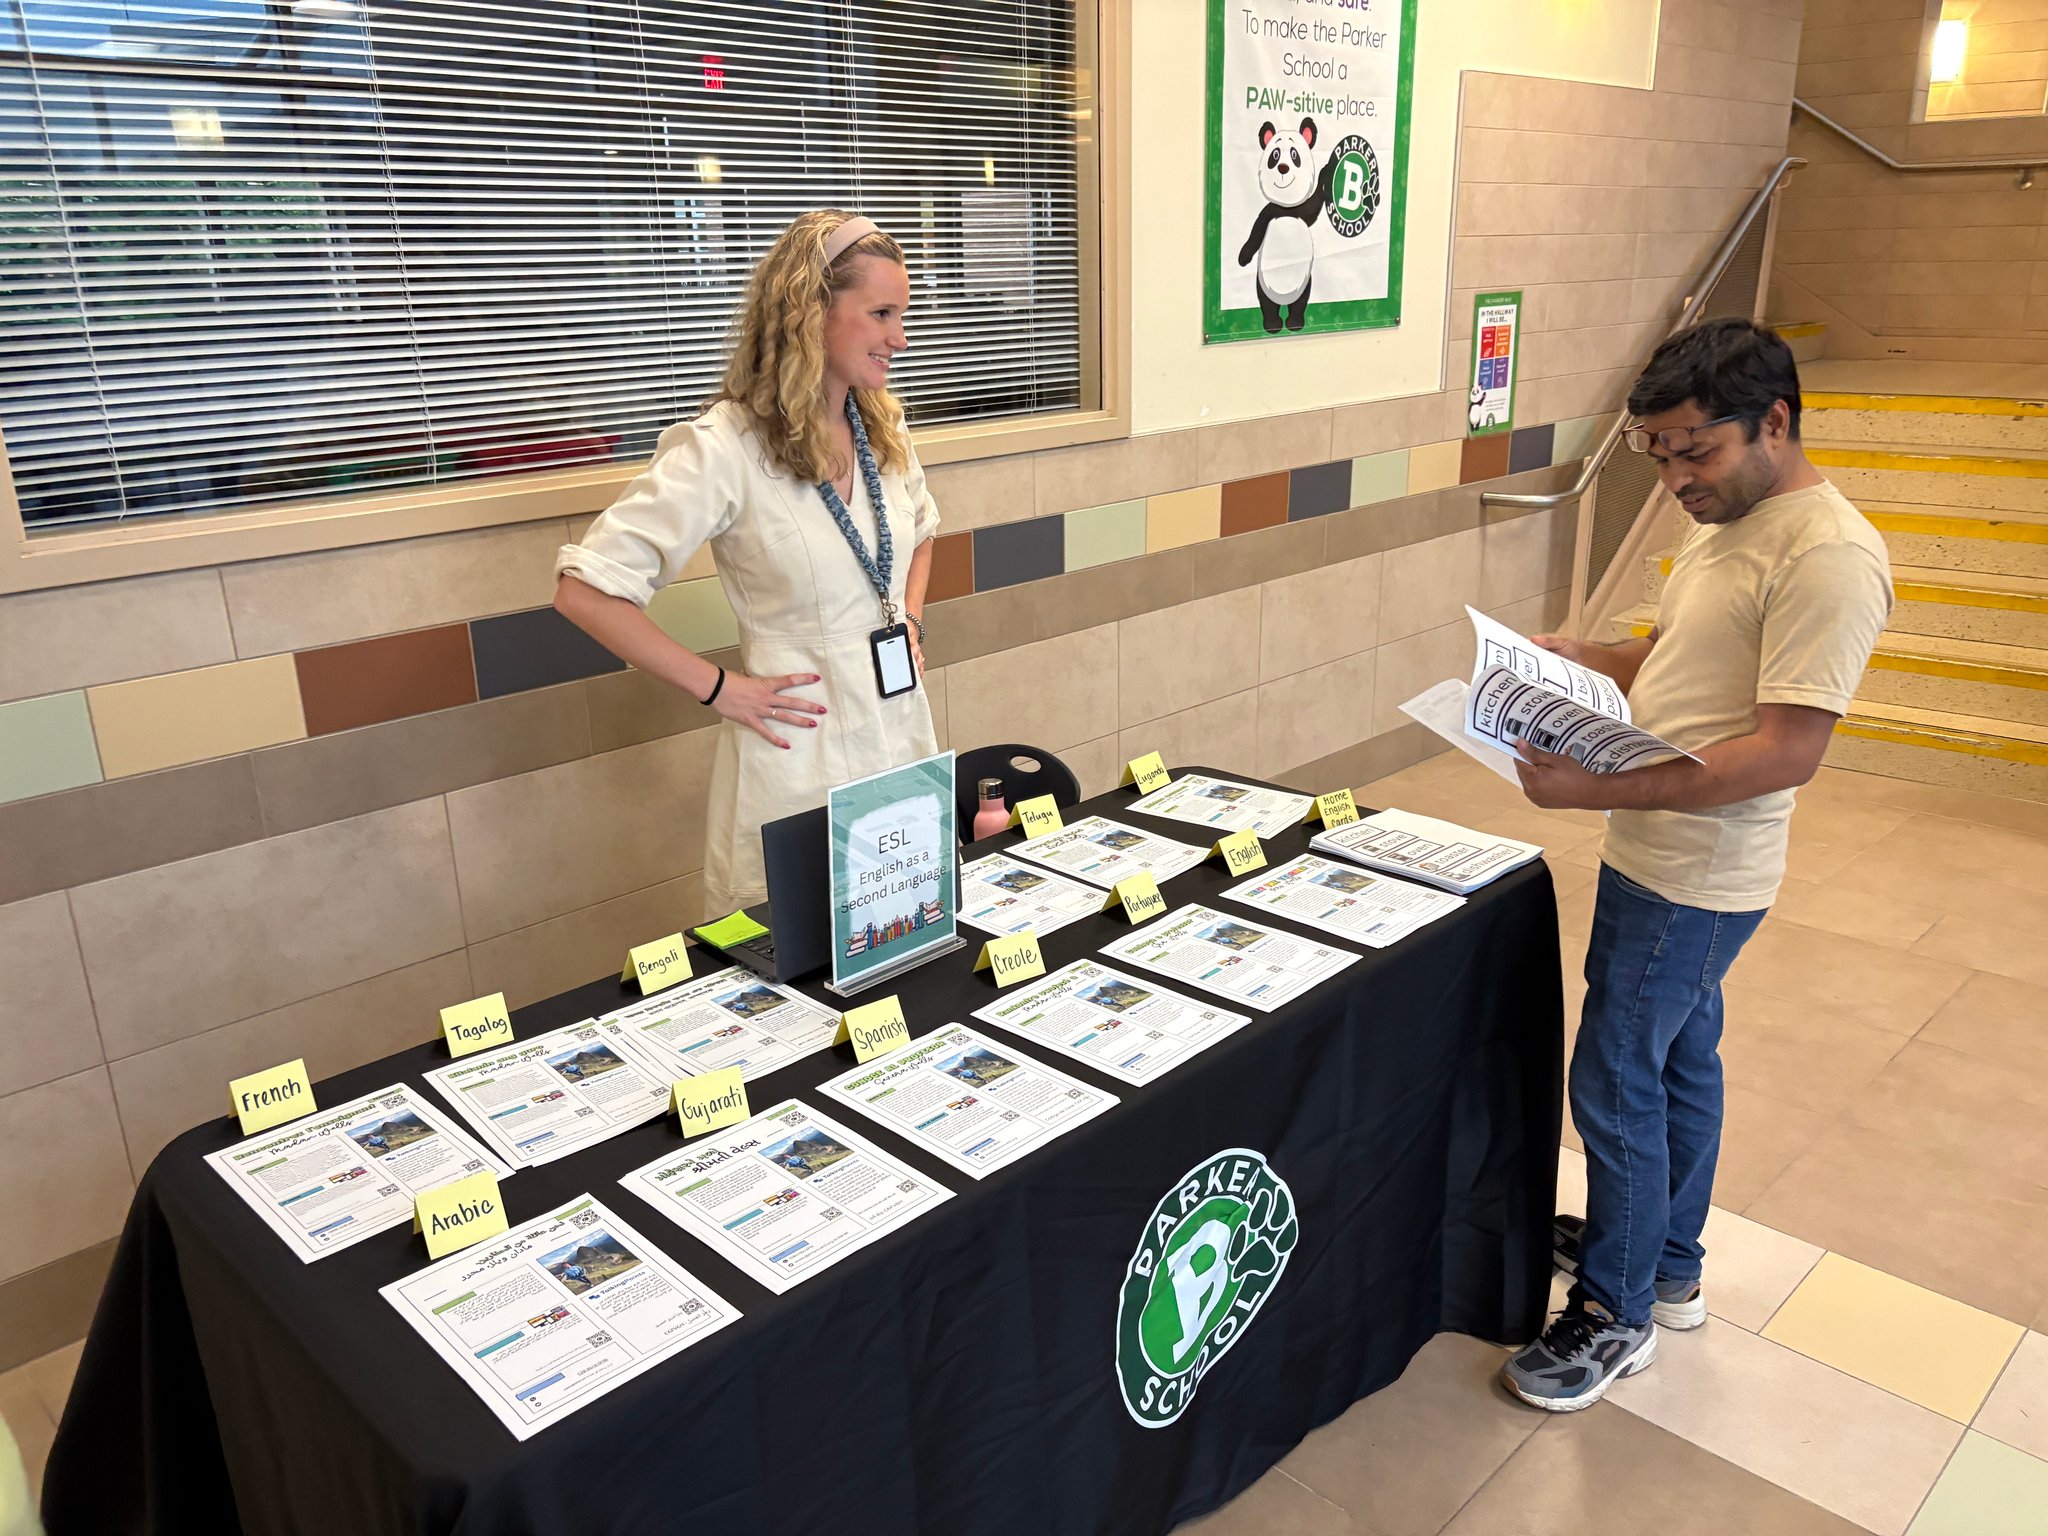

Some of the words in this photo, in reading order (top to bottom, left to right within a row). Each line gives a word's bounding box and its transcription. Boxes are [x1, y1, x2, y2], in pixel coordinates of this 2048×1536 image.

[1242, 10, 1259, 34] To
[1264, 16, 1307, 40] make
[1314, 19, 1337, 43] the
[1342, 22, 1386, 48] Parker
[1283, 53, 1334, 79] School
[1338, 64, 1347, 80] a
[1246, 87, 1333, 114] PAW-sitive
[1337, 94, 1377, 120] place.
[1334, 137, 1377, 172] PARKER
[1339, 160, 1363, 210] B
[1328, 203, 1369, 236] SCHOOL
[1480, 676, 1518, 728] kitchen
[1552, 707, 1584, 728] oven
[1323, 792, 1348, 805] Home
[1324, 802, 1350, 816] English
[1022, 809, 1053, 824] Telugu
[878, 828, 912, 854] ESL
[1337, 827, 1376, 845] kitchen
[1380, 833, 1407, 849] stove
[1407, 842, 1433, 856] oven
[1231, 842, 1261, 867] English
[1435, 847, 1469, 865] toaster
[1462, 847, 1513, 876] dishwasher
[859, 858, 902, 886] English
[906, 855, 920, 867] as
[922, 852, 930, 862] a
[841, 886, 887, 913] Second
[891, 864, 947, 894] Language
[638, 950, 679, 976] Bengali
[993, 947, 1036, 975] Creole
[451, 1017, 508, 1040] Tagalog
[854, 1016, 906, 1051] Spanish
[242, 1078, 301, 1112] French
[682, 1086, 743, 1124] Gujarati
[431, 1198, 495, 1235] Arabic
